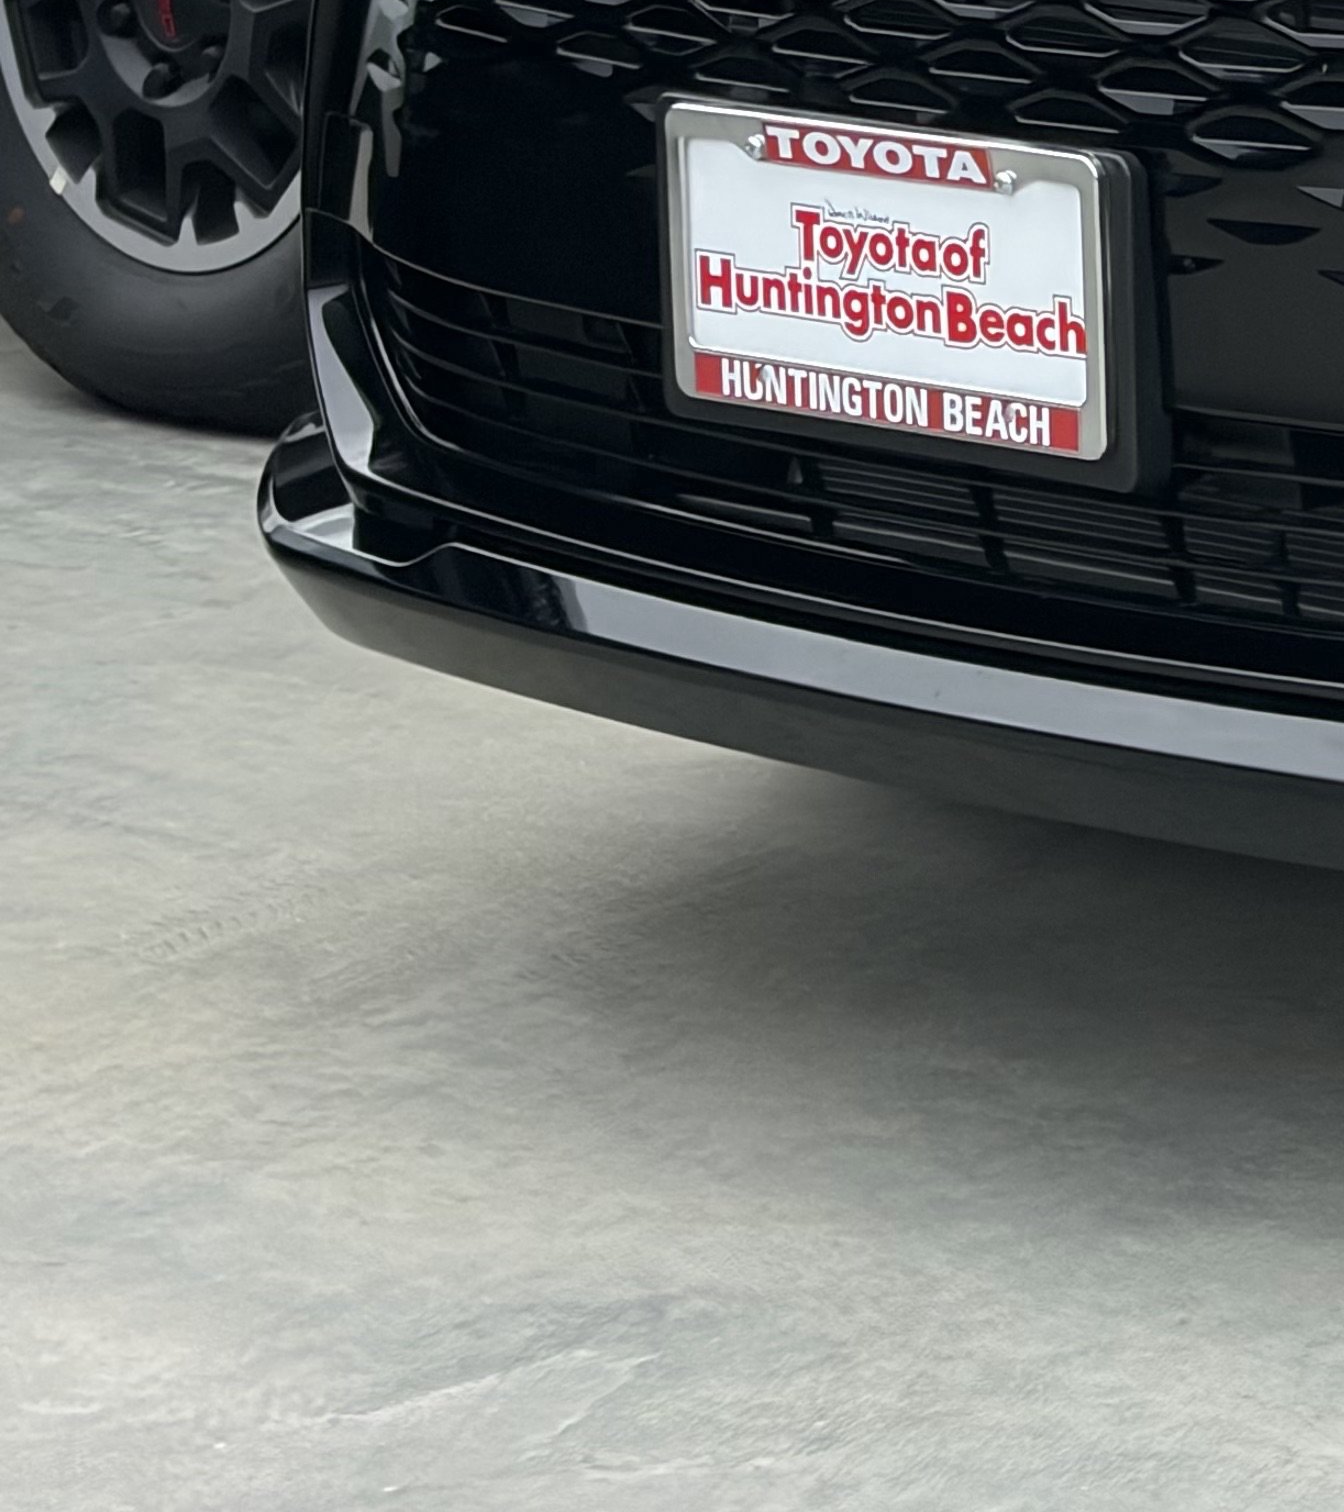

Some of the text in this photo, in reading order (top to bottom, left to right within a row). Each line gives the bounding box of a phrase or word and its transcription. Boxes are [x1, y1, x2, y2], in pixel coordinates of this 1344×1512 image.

[764, 125, 988, 185] TOYOTA
[721, 358, 1051, 447] HUNTINGTON BEACH
